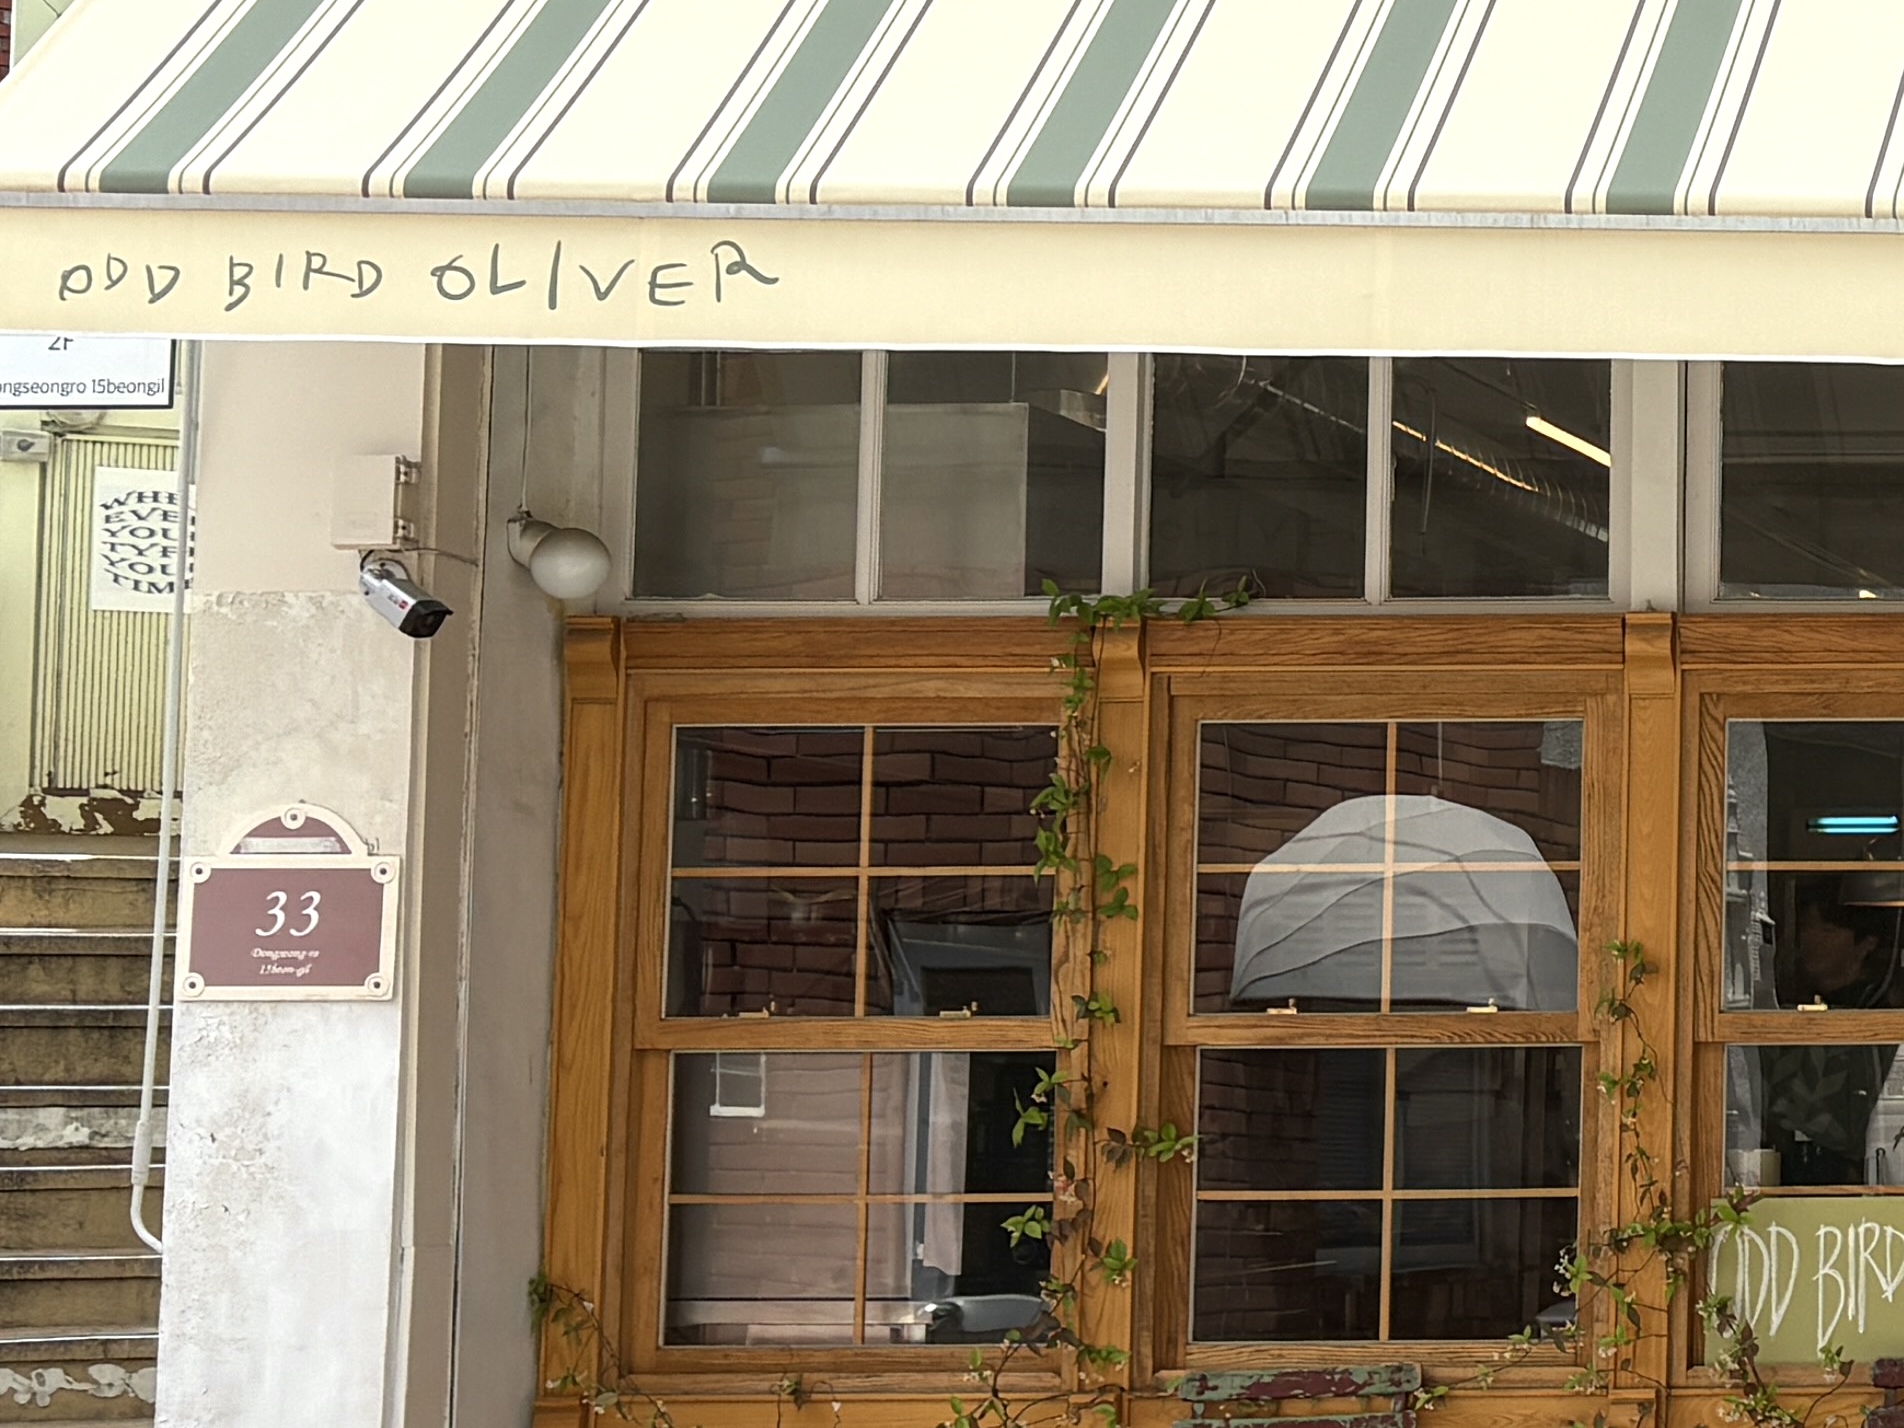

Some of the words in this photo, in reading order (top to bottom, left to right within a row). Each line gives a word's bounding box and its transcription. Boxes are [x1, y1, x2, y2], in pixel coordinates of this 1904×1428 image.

[58, 253, 180, 304] ODD
[225, 250, 384, 312] BIRD
[430, 239, 779, 310] OLIVER
[91, 378, 165, 397] 15beongil
[99, 490, 179, 510] WHE
[104, 506, 195, 526] EVE
[101, 524, 195, 541] YOU
[100, 540, 194, 558] TYP
[100, 553, 194, 576] YOU
[255, 890, 321, 937] 33
